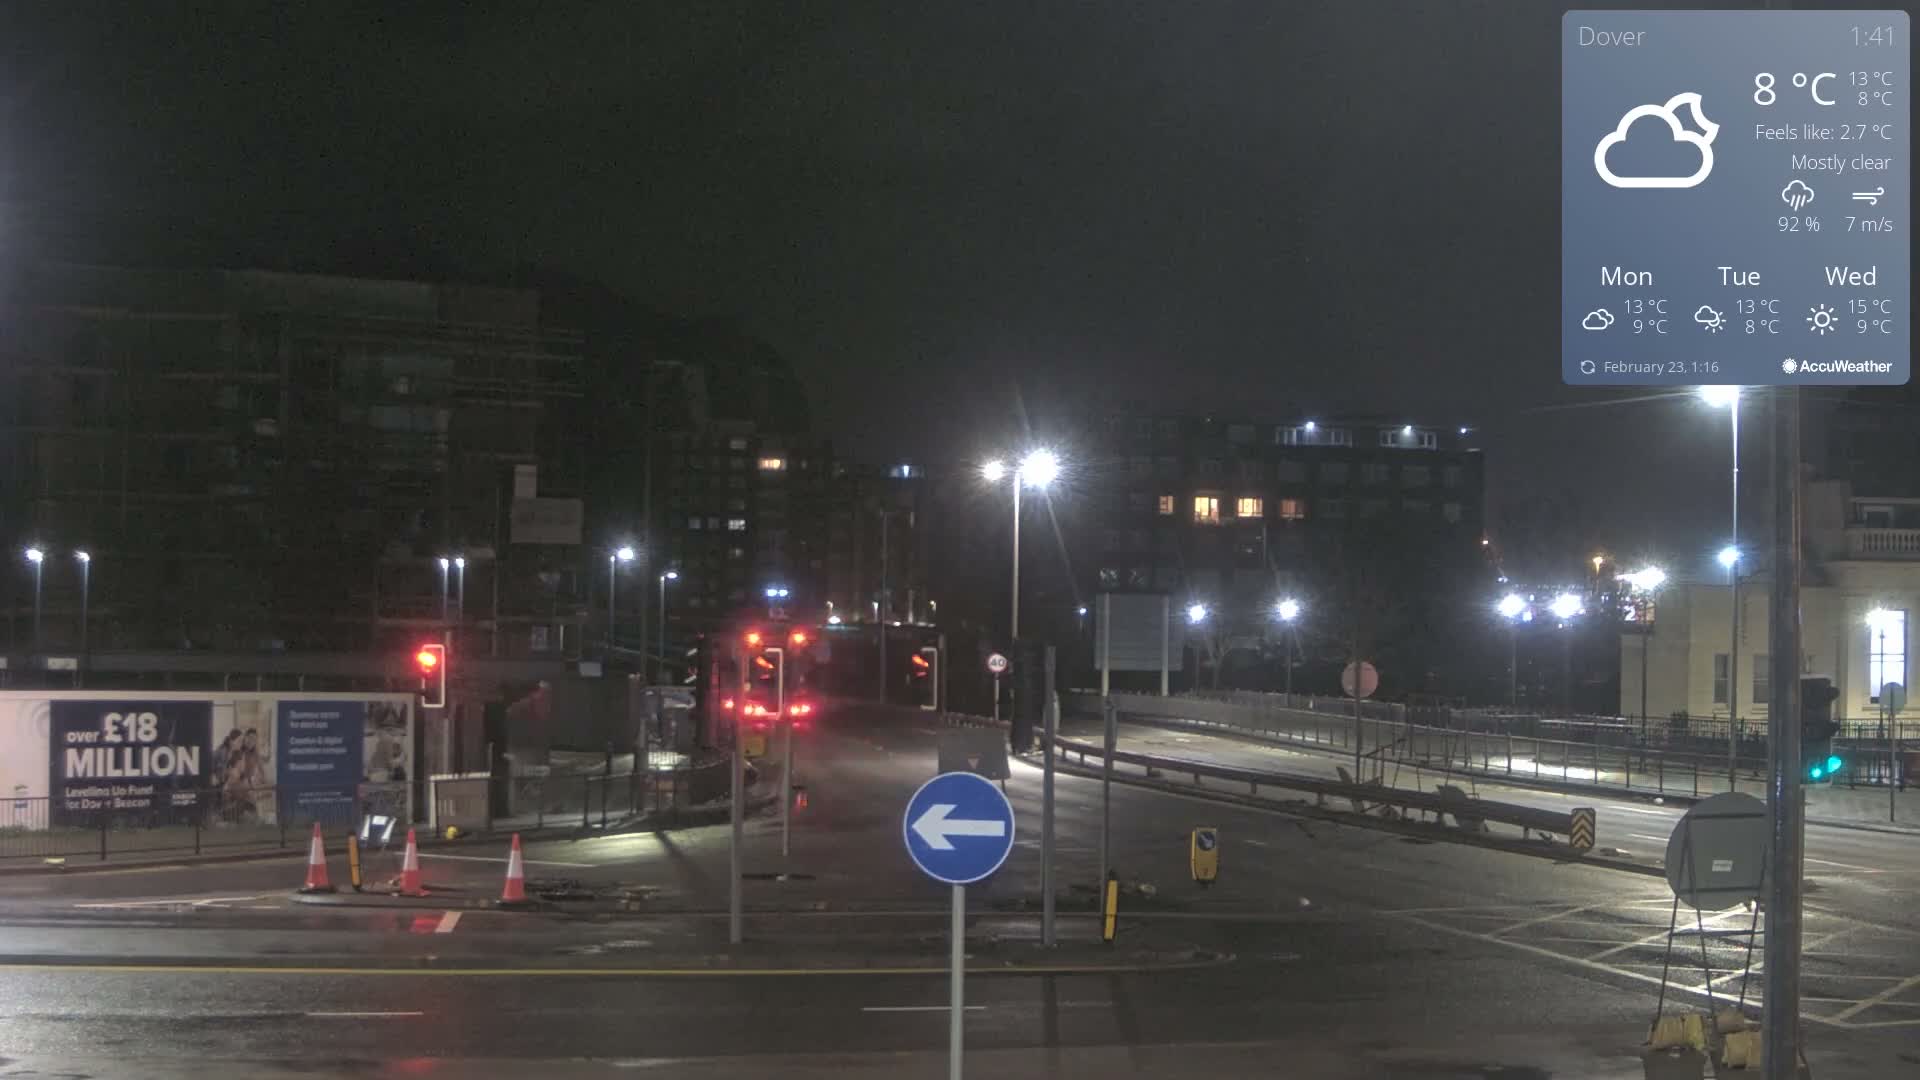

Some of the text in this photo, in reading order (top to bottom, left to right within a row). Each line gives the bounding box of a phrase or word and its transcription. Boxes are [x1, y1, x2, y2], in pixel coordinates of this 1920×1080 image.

[991, 659, 1005, 667] 40
[66, 712, 158, 743] over £18
[66, 746, 199, 777] MILLION
[129, 785, 153, 796] Fund
[81, 799, 111, 809] Dovr
